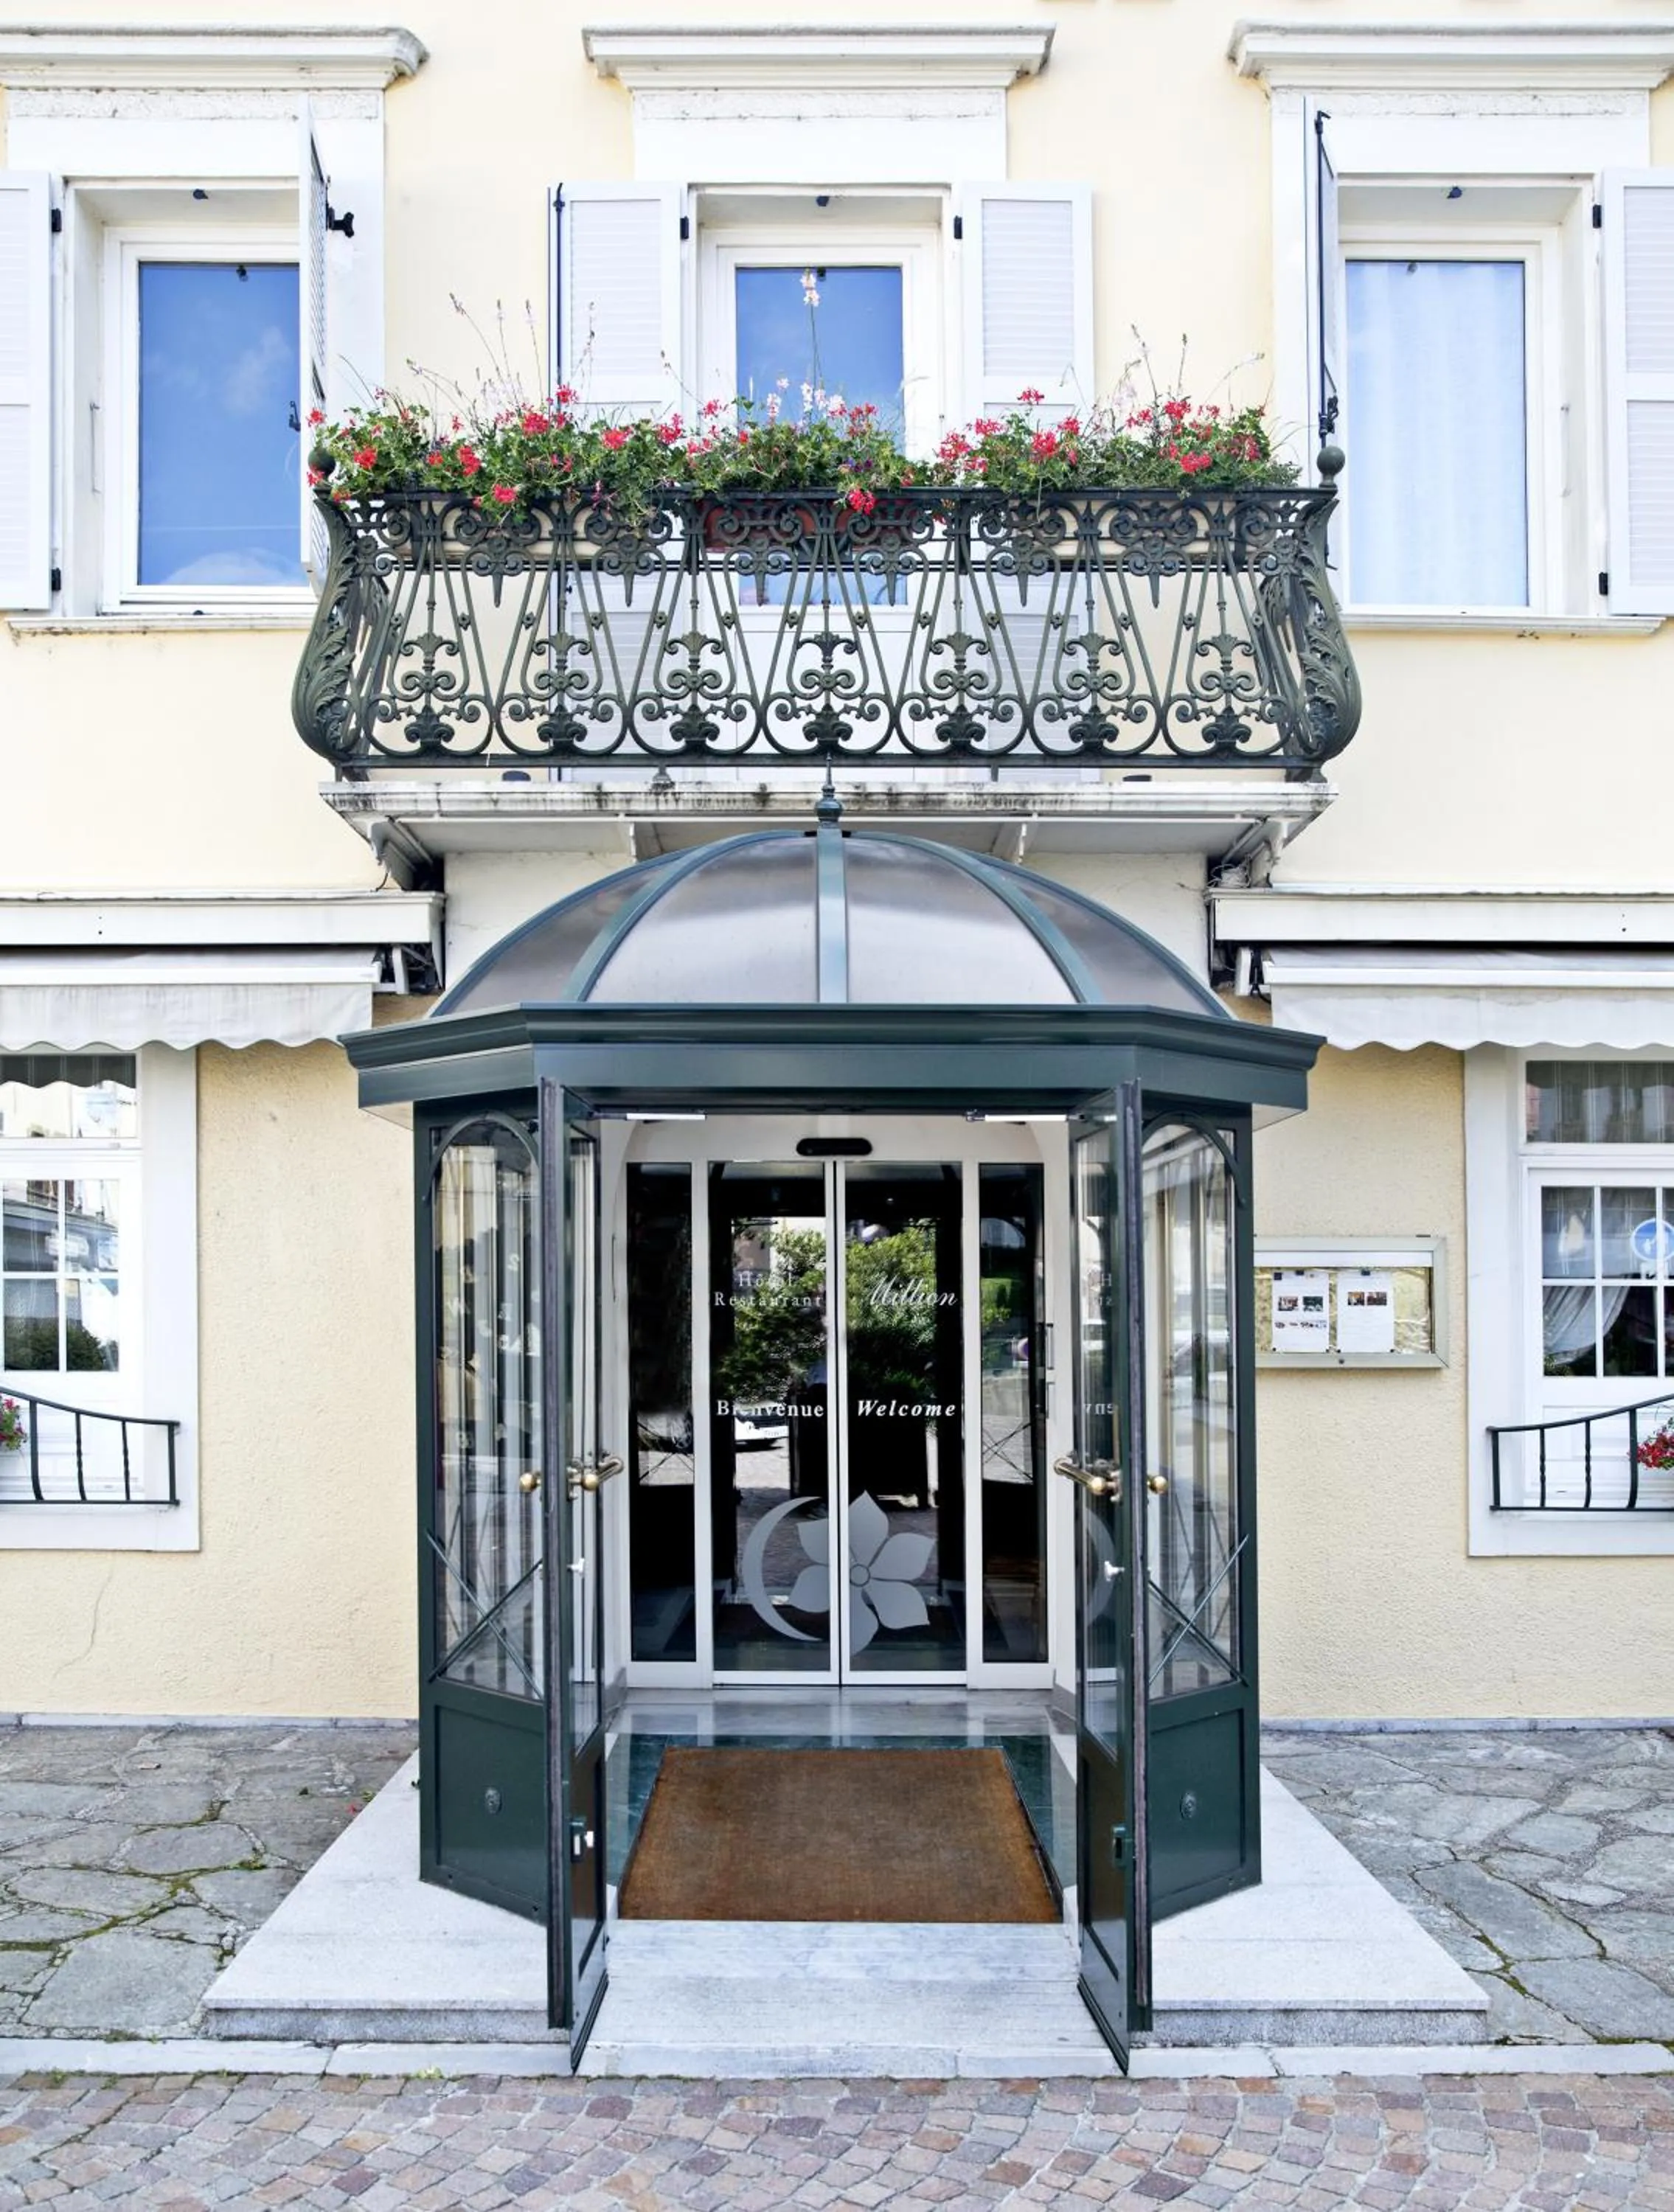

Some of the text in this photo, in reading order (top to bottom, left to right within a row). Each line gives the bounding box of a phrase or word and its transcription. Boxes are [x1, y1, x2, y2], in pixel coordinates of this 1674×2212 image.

[868, 1272, 958, 1306] Million
[714, 1292, 823, 1307] Restaurant
[857, 1399, 956, 1416] Welcome
